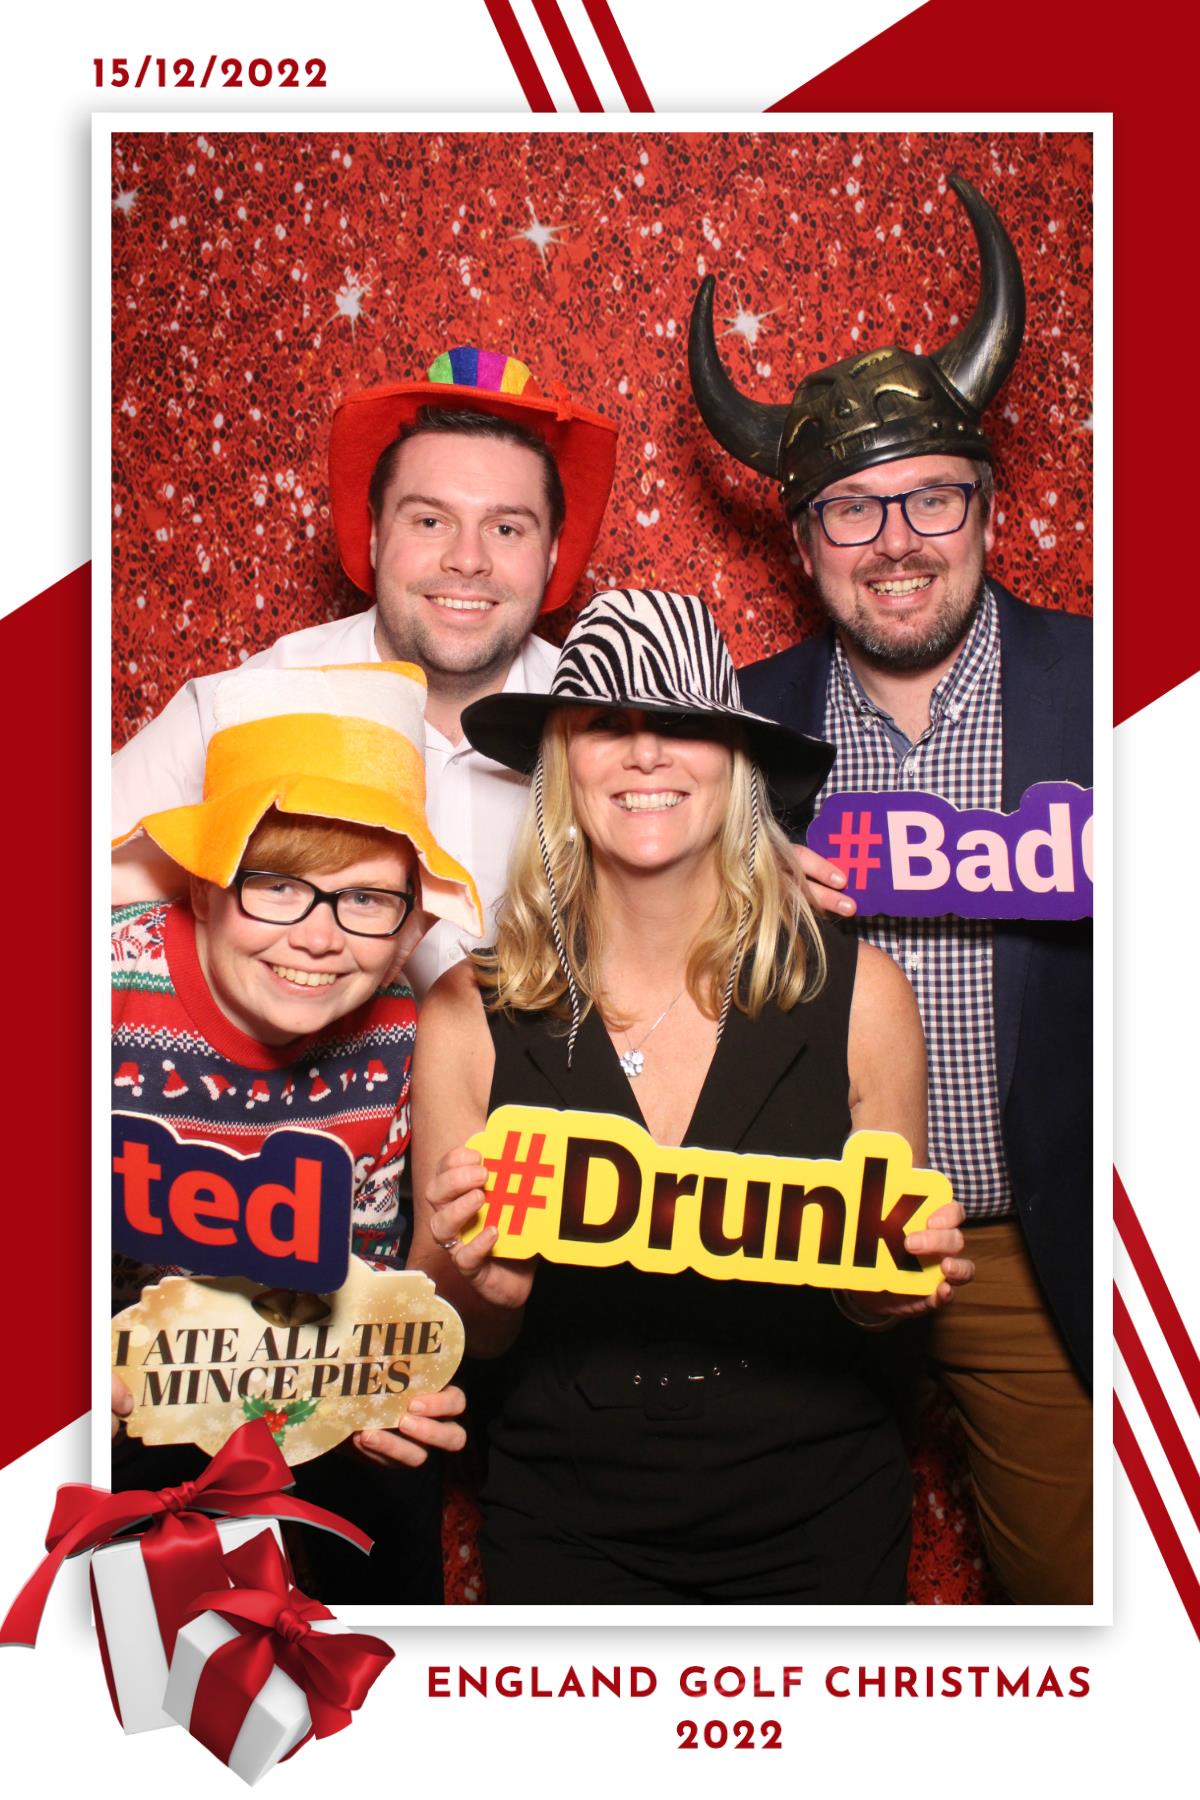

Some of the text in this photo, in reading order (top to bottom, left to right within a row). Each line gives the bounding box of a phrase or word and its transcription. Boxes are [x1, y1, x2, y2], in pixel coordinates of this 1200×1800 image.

[483, 1131, 928, 1271] #Drunk
[114, 1320, 444, 1367] I ATE ALL THE
[140, 1361, 413, 1407] MINCE PIES
